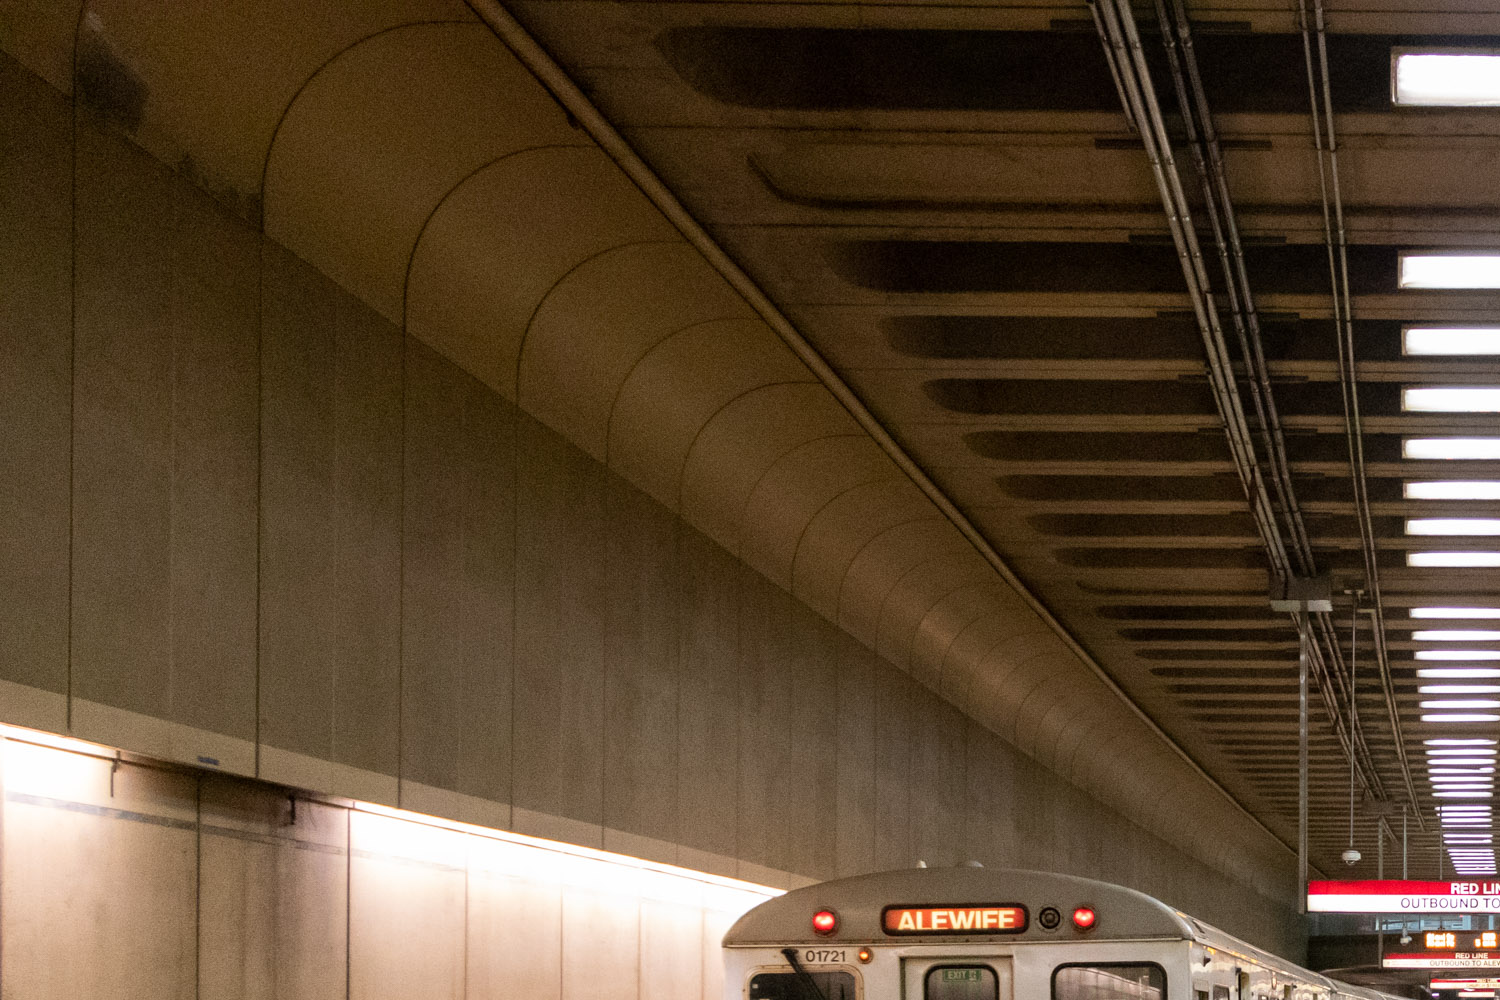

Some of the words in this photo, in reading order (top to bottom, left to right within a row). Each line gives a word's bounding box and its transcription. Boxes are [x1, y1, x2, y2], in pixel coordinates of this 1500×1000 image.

[1450, 883, 1479, 895] RED
[1400, 897, 1479, 909] OUTBOUND
[1483, 897, 1500, 909] TO
[898, 911, 1015, 930] ALEWIFE
[805, 950, 846, 962] 01721
[947, 970, 967, 979] EXIT
